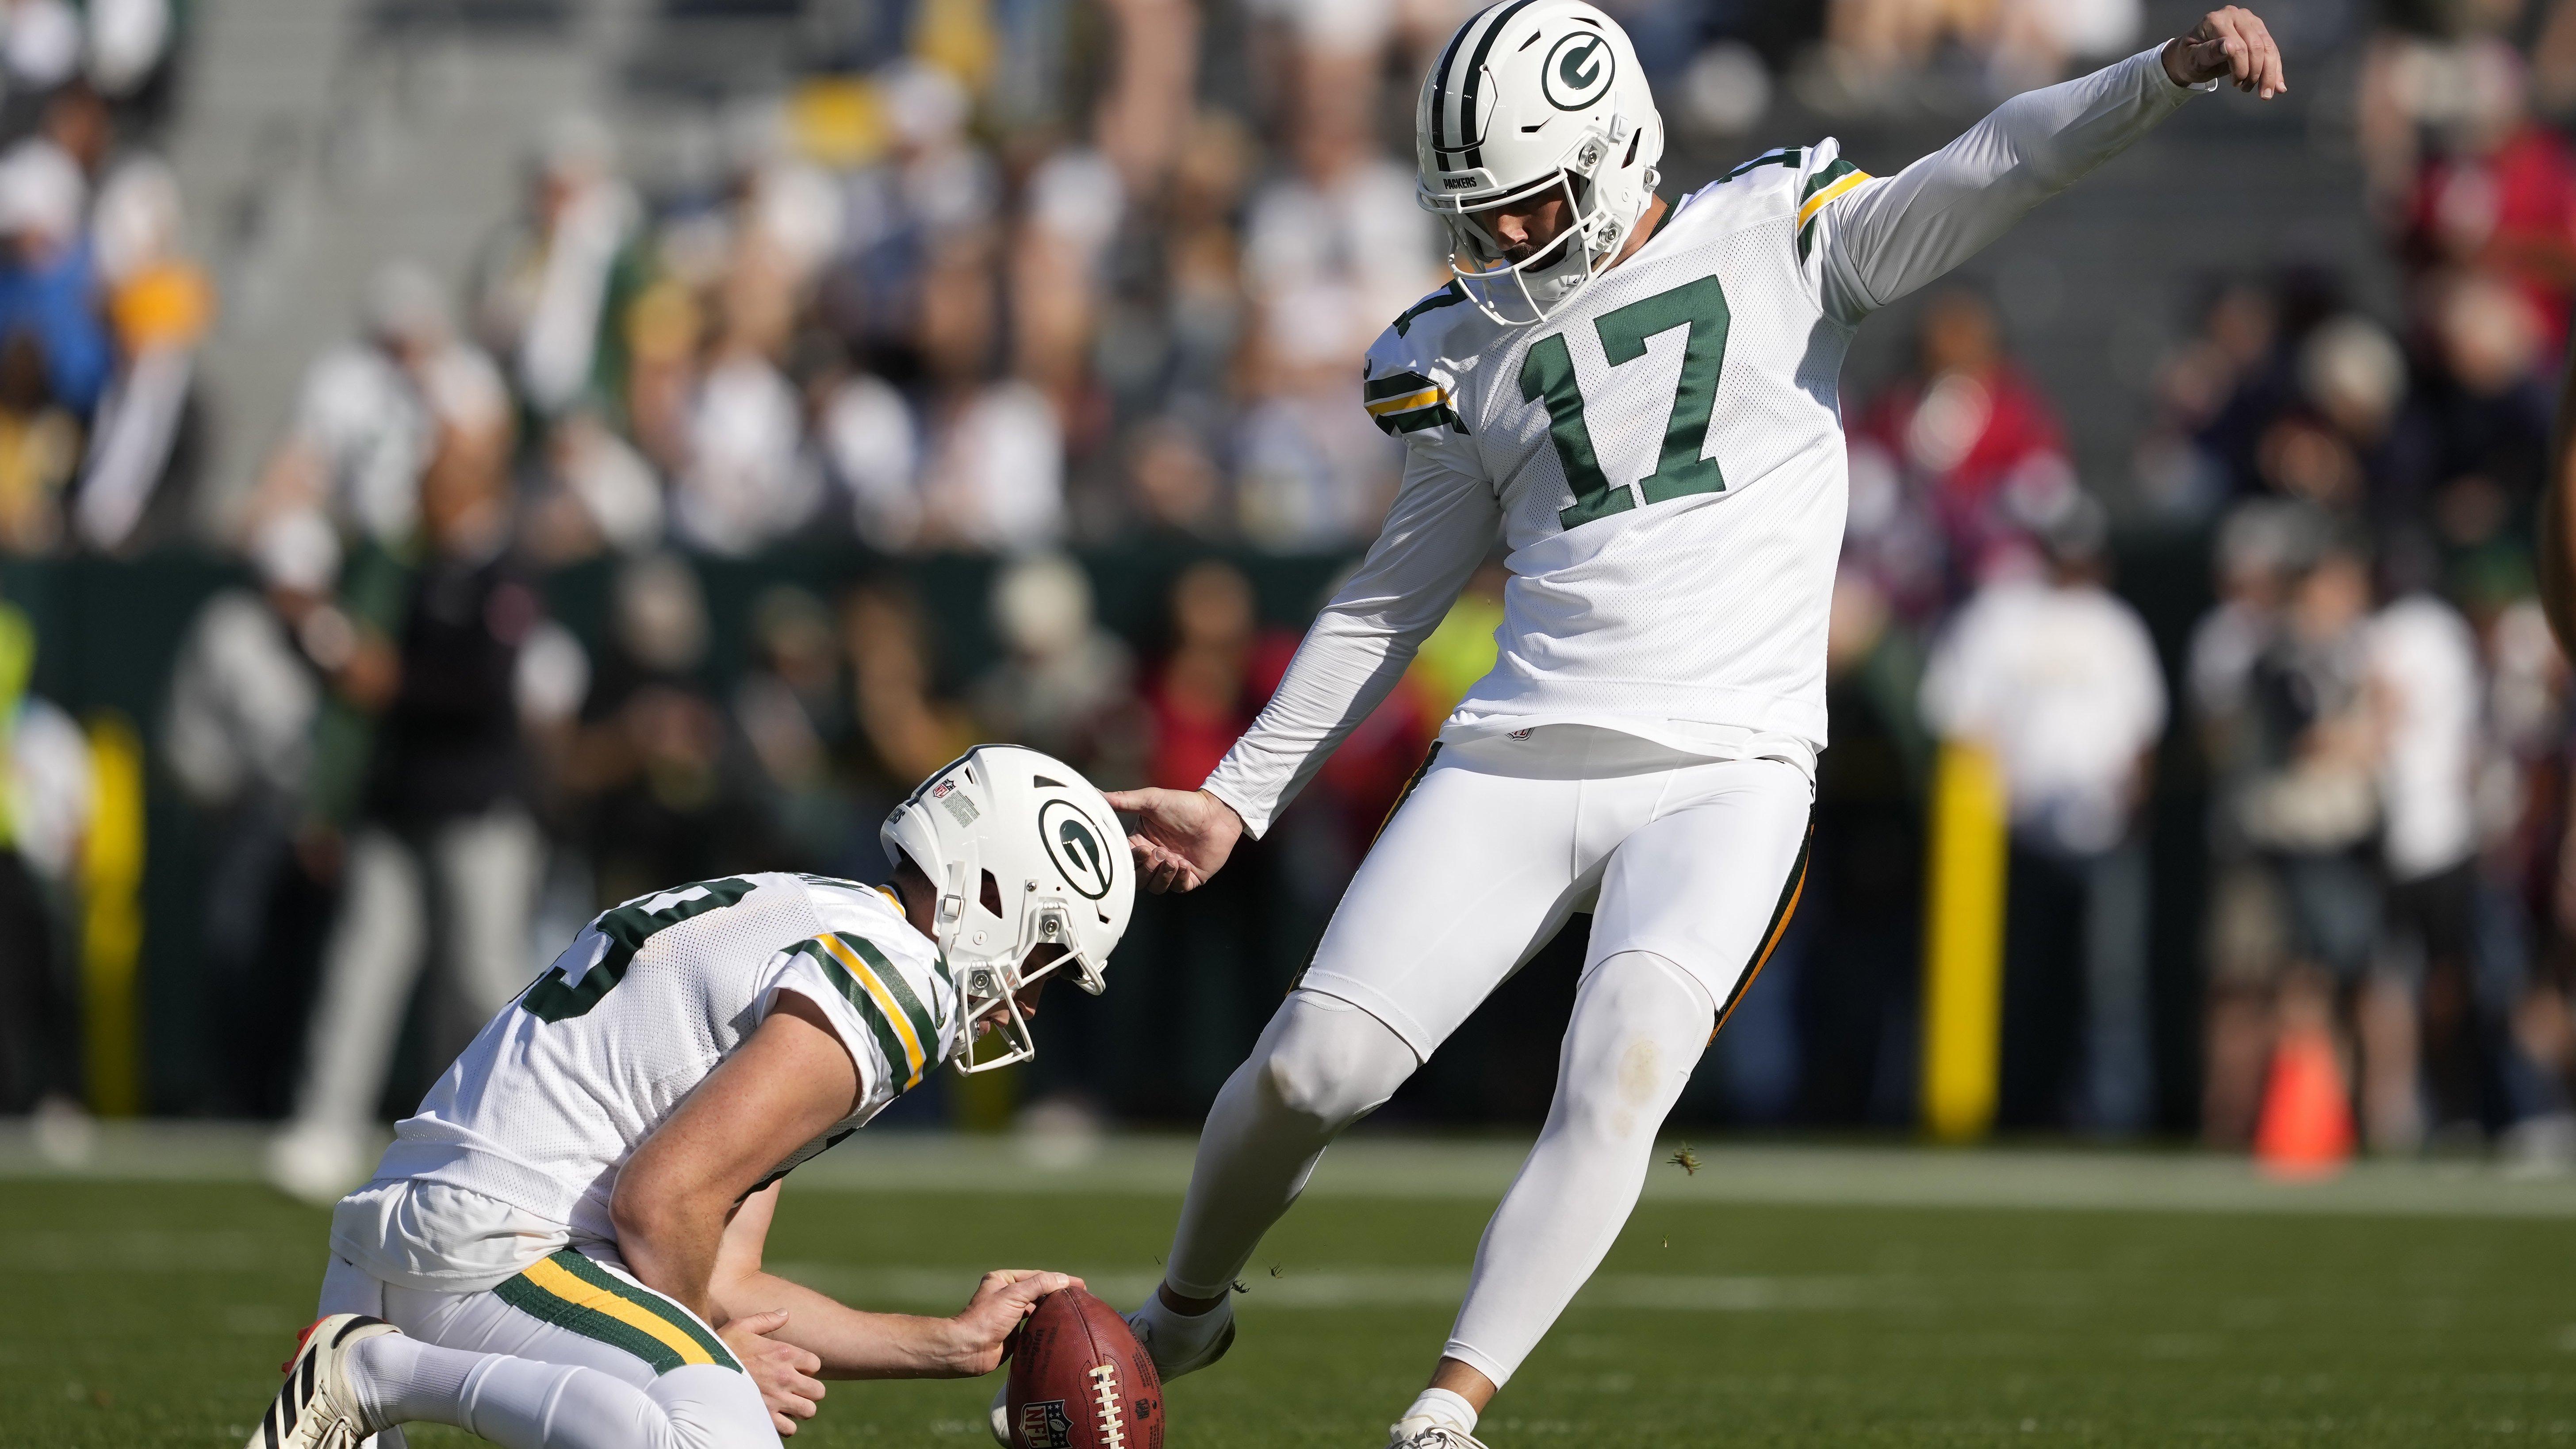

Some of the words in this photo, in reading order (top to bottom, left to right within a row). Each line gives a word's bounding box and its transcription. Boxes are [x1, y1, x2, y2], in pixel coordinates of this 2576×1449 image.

[1544, 33, 1614, 109] G
[1443, 176, 1477, 190] PACKERS
[1518, 274, 1731, 531] 17
[1041, 801, 1112, 897] G
[1024, 1407, 1049, 1447] NFL
